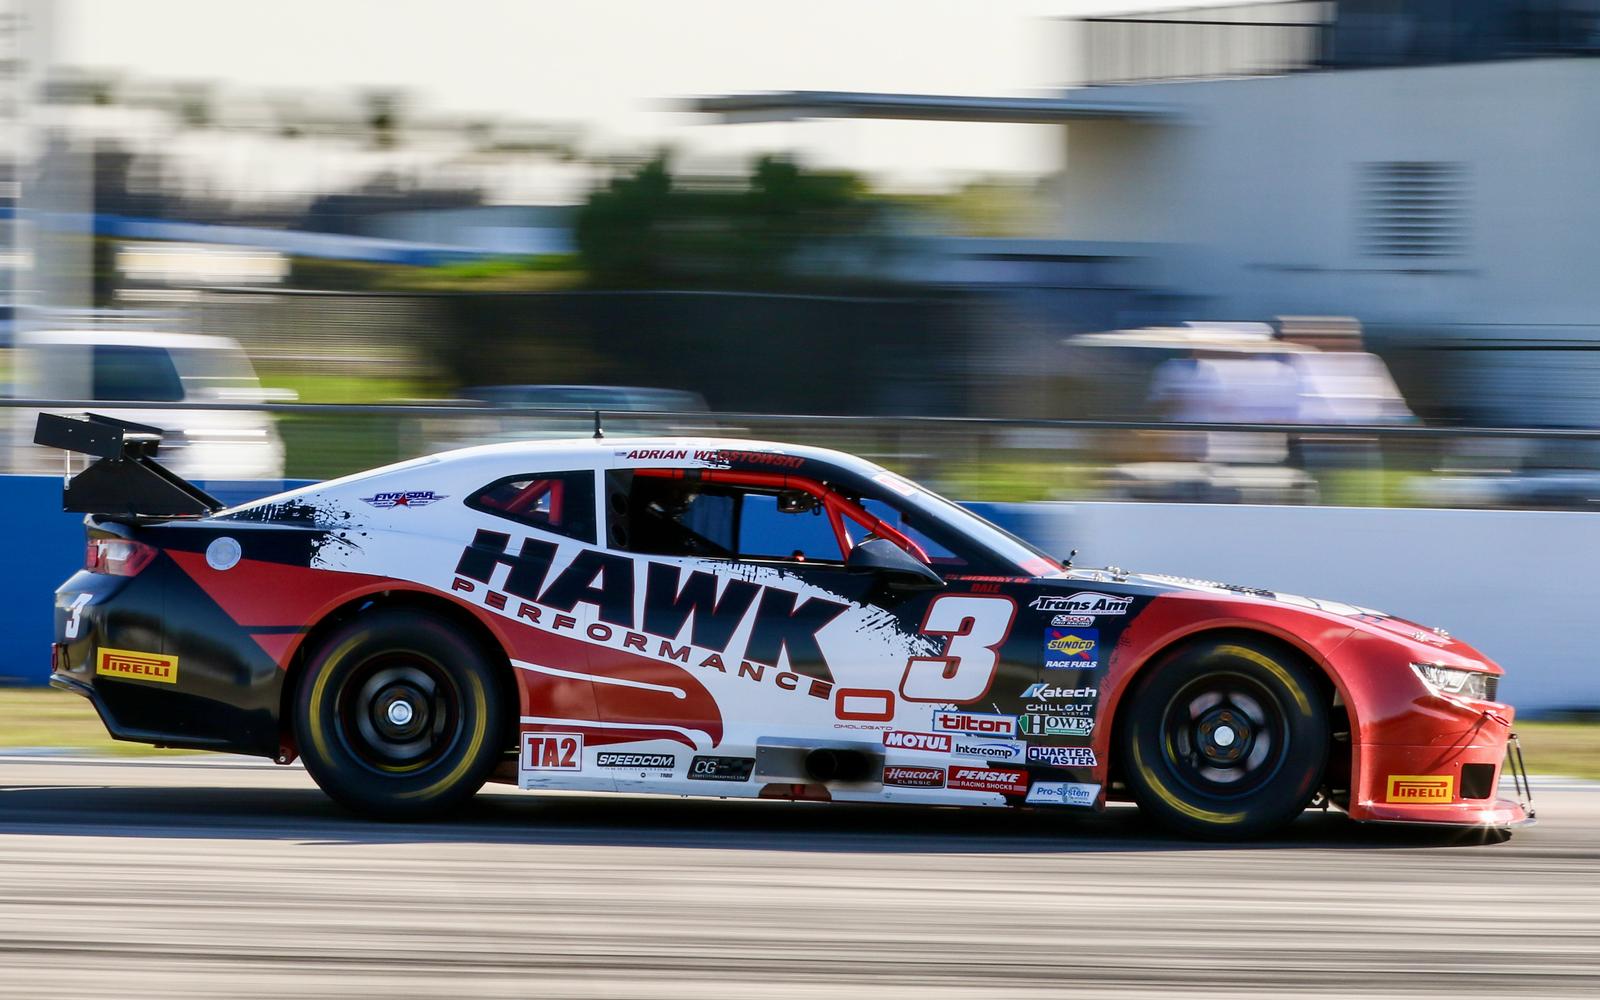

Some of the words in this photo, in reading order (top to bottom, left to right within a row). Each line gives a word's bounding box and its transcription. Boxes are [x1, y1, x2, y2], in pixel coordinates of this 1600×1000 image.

[626, 450, 688, 460] ADRIAN
[374, 492, 401, 501] FIVE
[405, 490, 435, 499] STAR
[454, 528, 852, 685] HAWK
[1029, 596, 1090, 611] Trans
[1091, 598, 1129, 611] Am
[65, 593, 93, 639] 3
[451, 576, 836, 701] PERFORMANCE
[1050, 640, 1093, 649] SUNOCO
[899, 592, 1019, 705] 3
[102, 653, 171, 678] PIRELLI
[1045, 660, 1070, 668] RACE
[1071, 660, 1098, 668] FUELS
[1032, 683, 1097, 702] Katech
[939, 714, 1012, 733] tilton
[885, 732, 949, 750] MOTUL
[528, 737, 577, 768] TA2
[955, 743, 1013, 759] Intercomp
[1029, 747, 1092, 759] QUARTER
[598, 754, 672, 766] SPEEDCOM
[694, 760, 717, 774] CG
[1040, 755, 1095, 765] MASTER
[885, 767, 942, 780] Heacock
[956, 769, 1021, 783] PENSKE
[961, 781, 986, 789] RACING
[987, 783, 1013, 791] SHOCKS
[1036, 786, 1090, 798] Pro-System
[1393, 780, 1448, 798] PIRELLI
